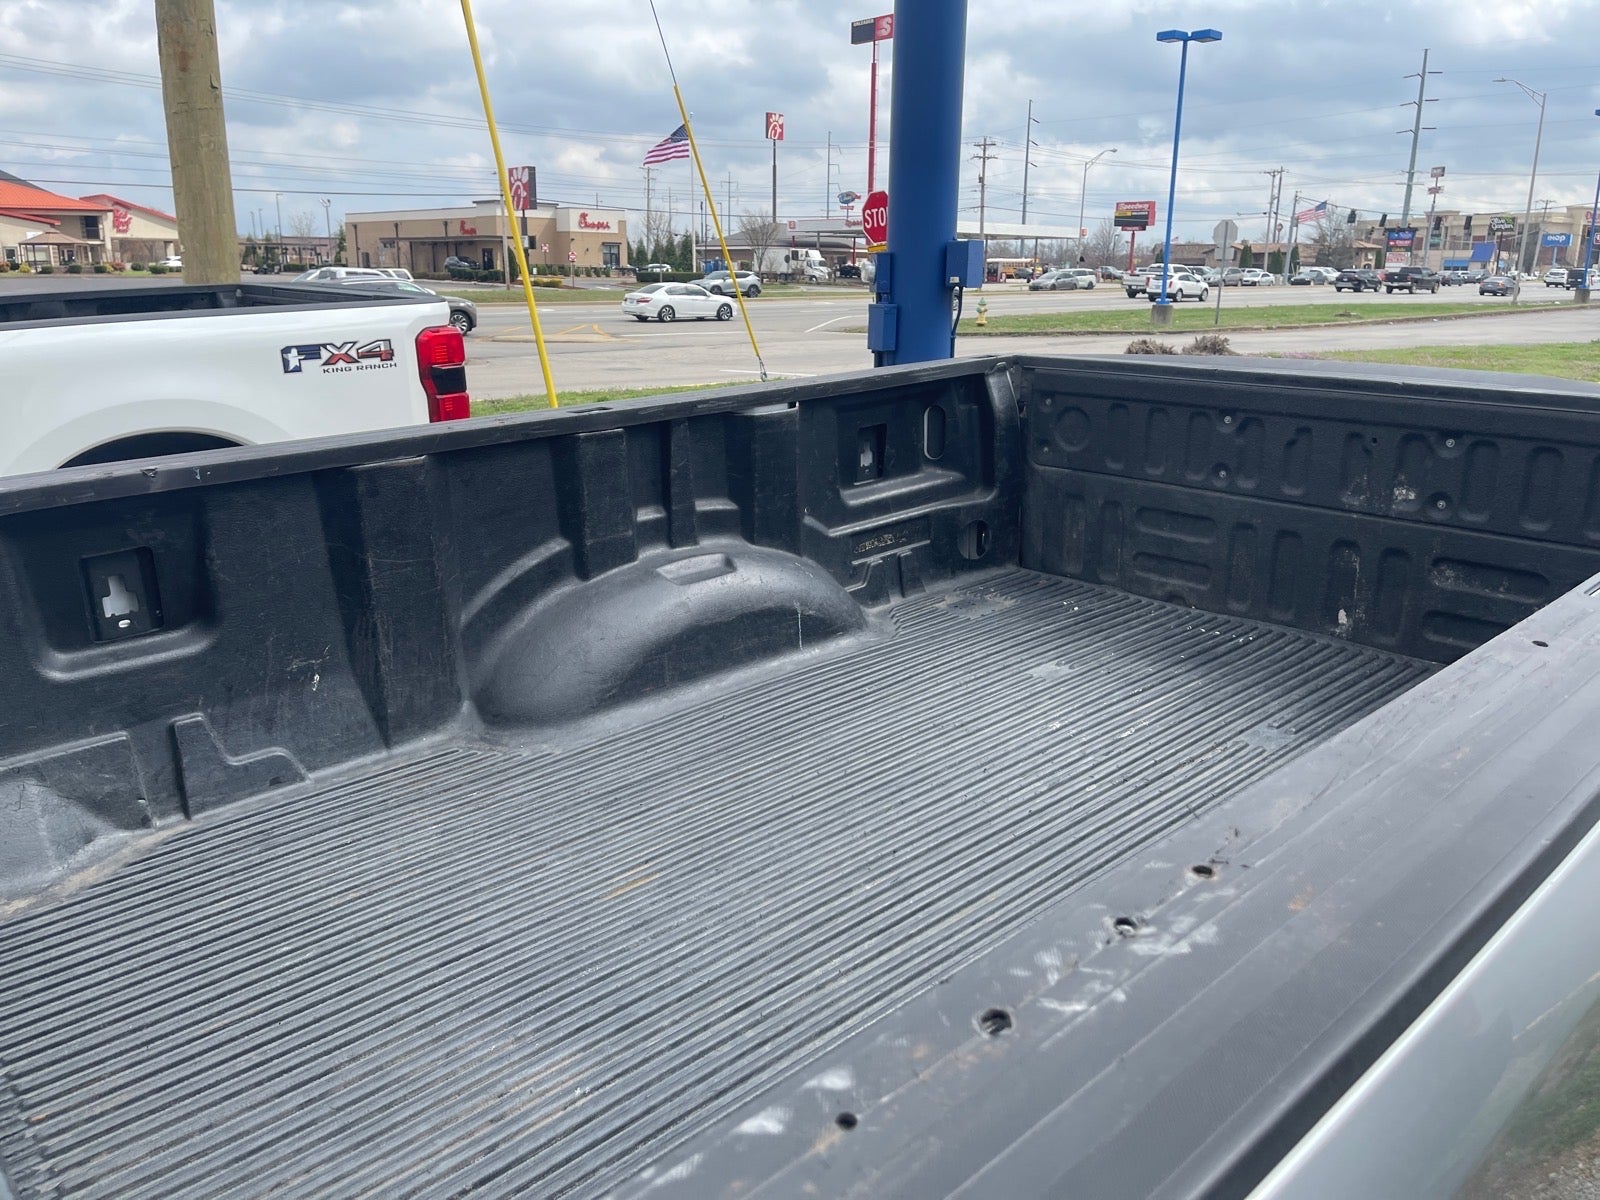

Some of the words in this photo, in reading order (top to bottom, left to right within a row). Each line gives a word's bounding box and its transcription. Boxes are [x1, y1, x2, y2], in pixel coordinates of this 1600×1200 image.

[864, 207, 888, 229] STO
[280, 339, 394, 374] FX4
[322, 366, 352, 374] KING
[356, 362, 397, 371] RANCH
